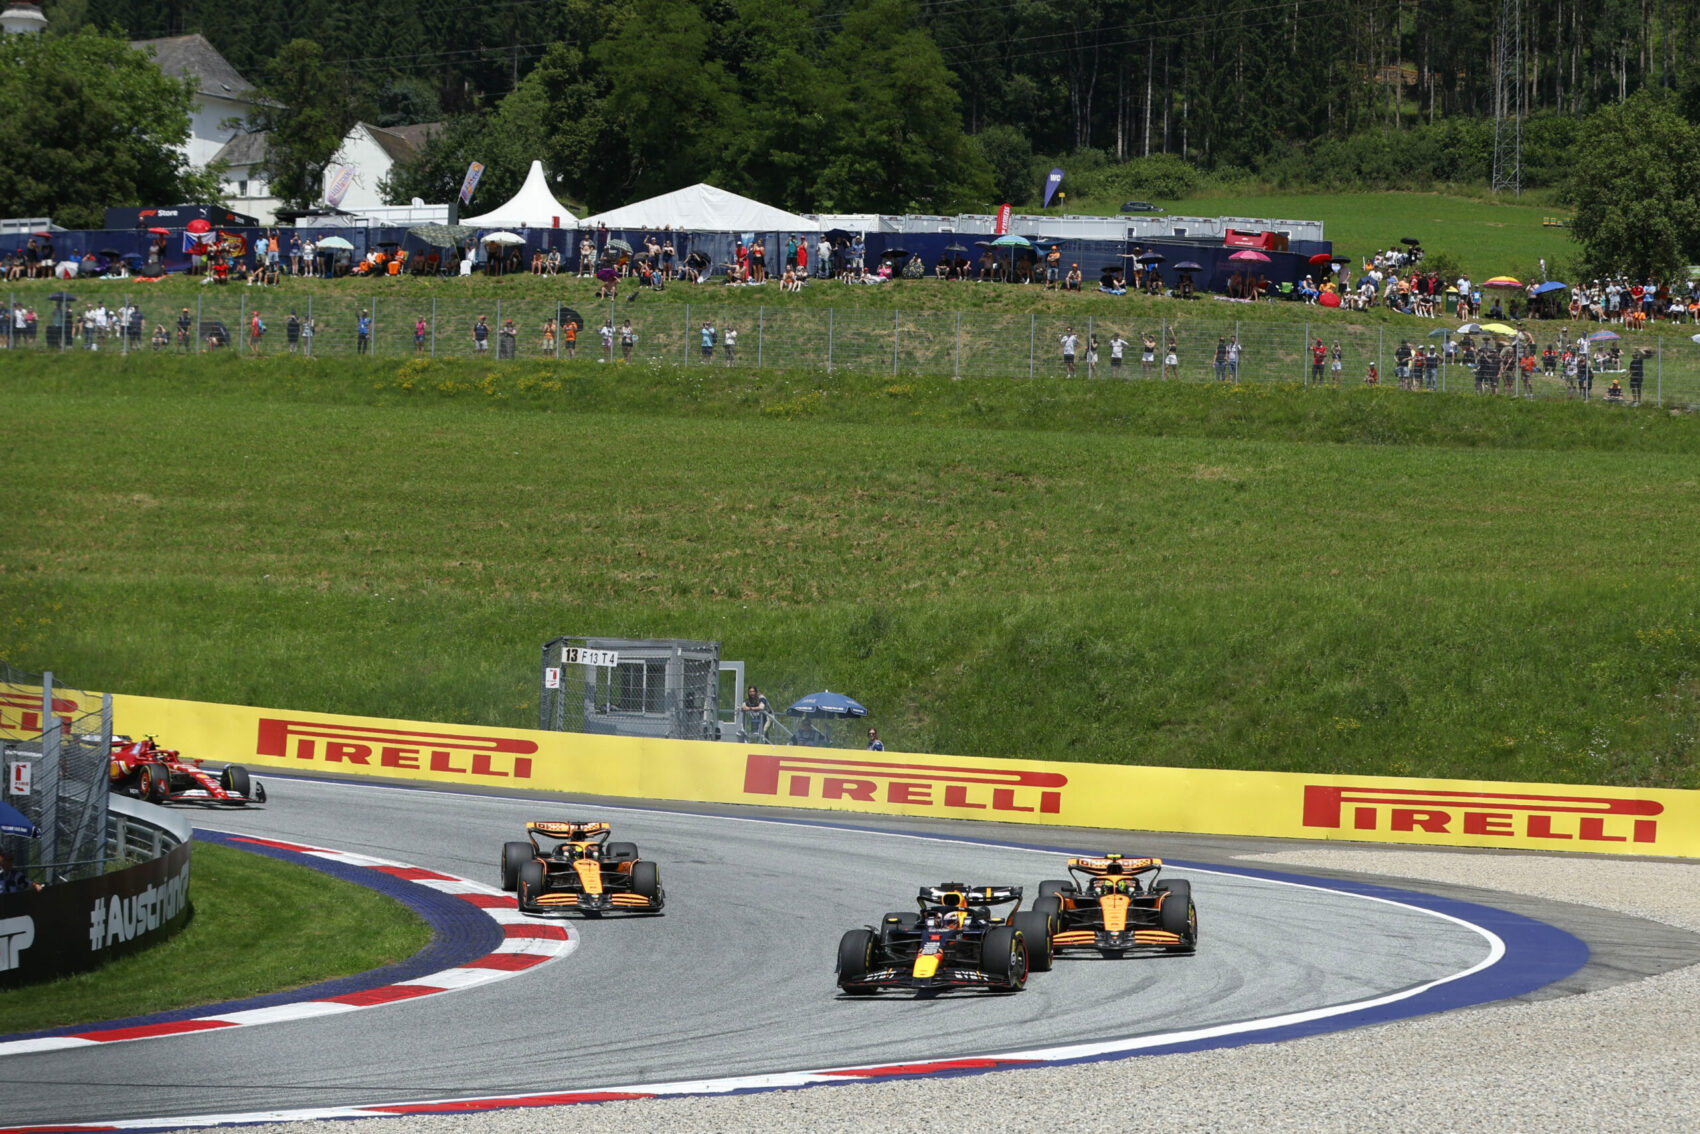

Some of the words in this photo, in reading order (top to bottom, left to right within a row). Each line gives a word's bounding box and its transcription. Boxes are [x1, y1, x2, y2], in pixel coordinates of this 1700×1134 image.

[1050, 174, 1062, 182] WC
[158, 209, 179, 217] Store
[566, 648, 579, 662] 13
[581, 651, 588, 662] F
[590, 652, 599, 664] 13
[602, 652, 608, 664] T
[609, 653, 615, 665] 4
[257, 718, 539, 778] PIRELLI
[743, 754, 1068, 814] PIRELLI
[1302, 785, 1664, 843] PIRELLI
